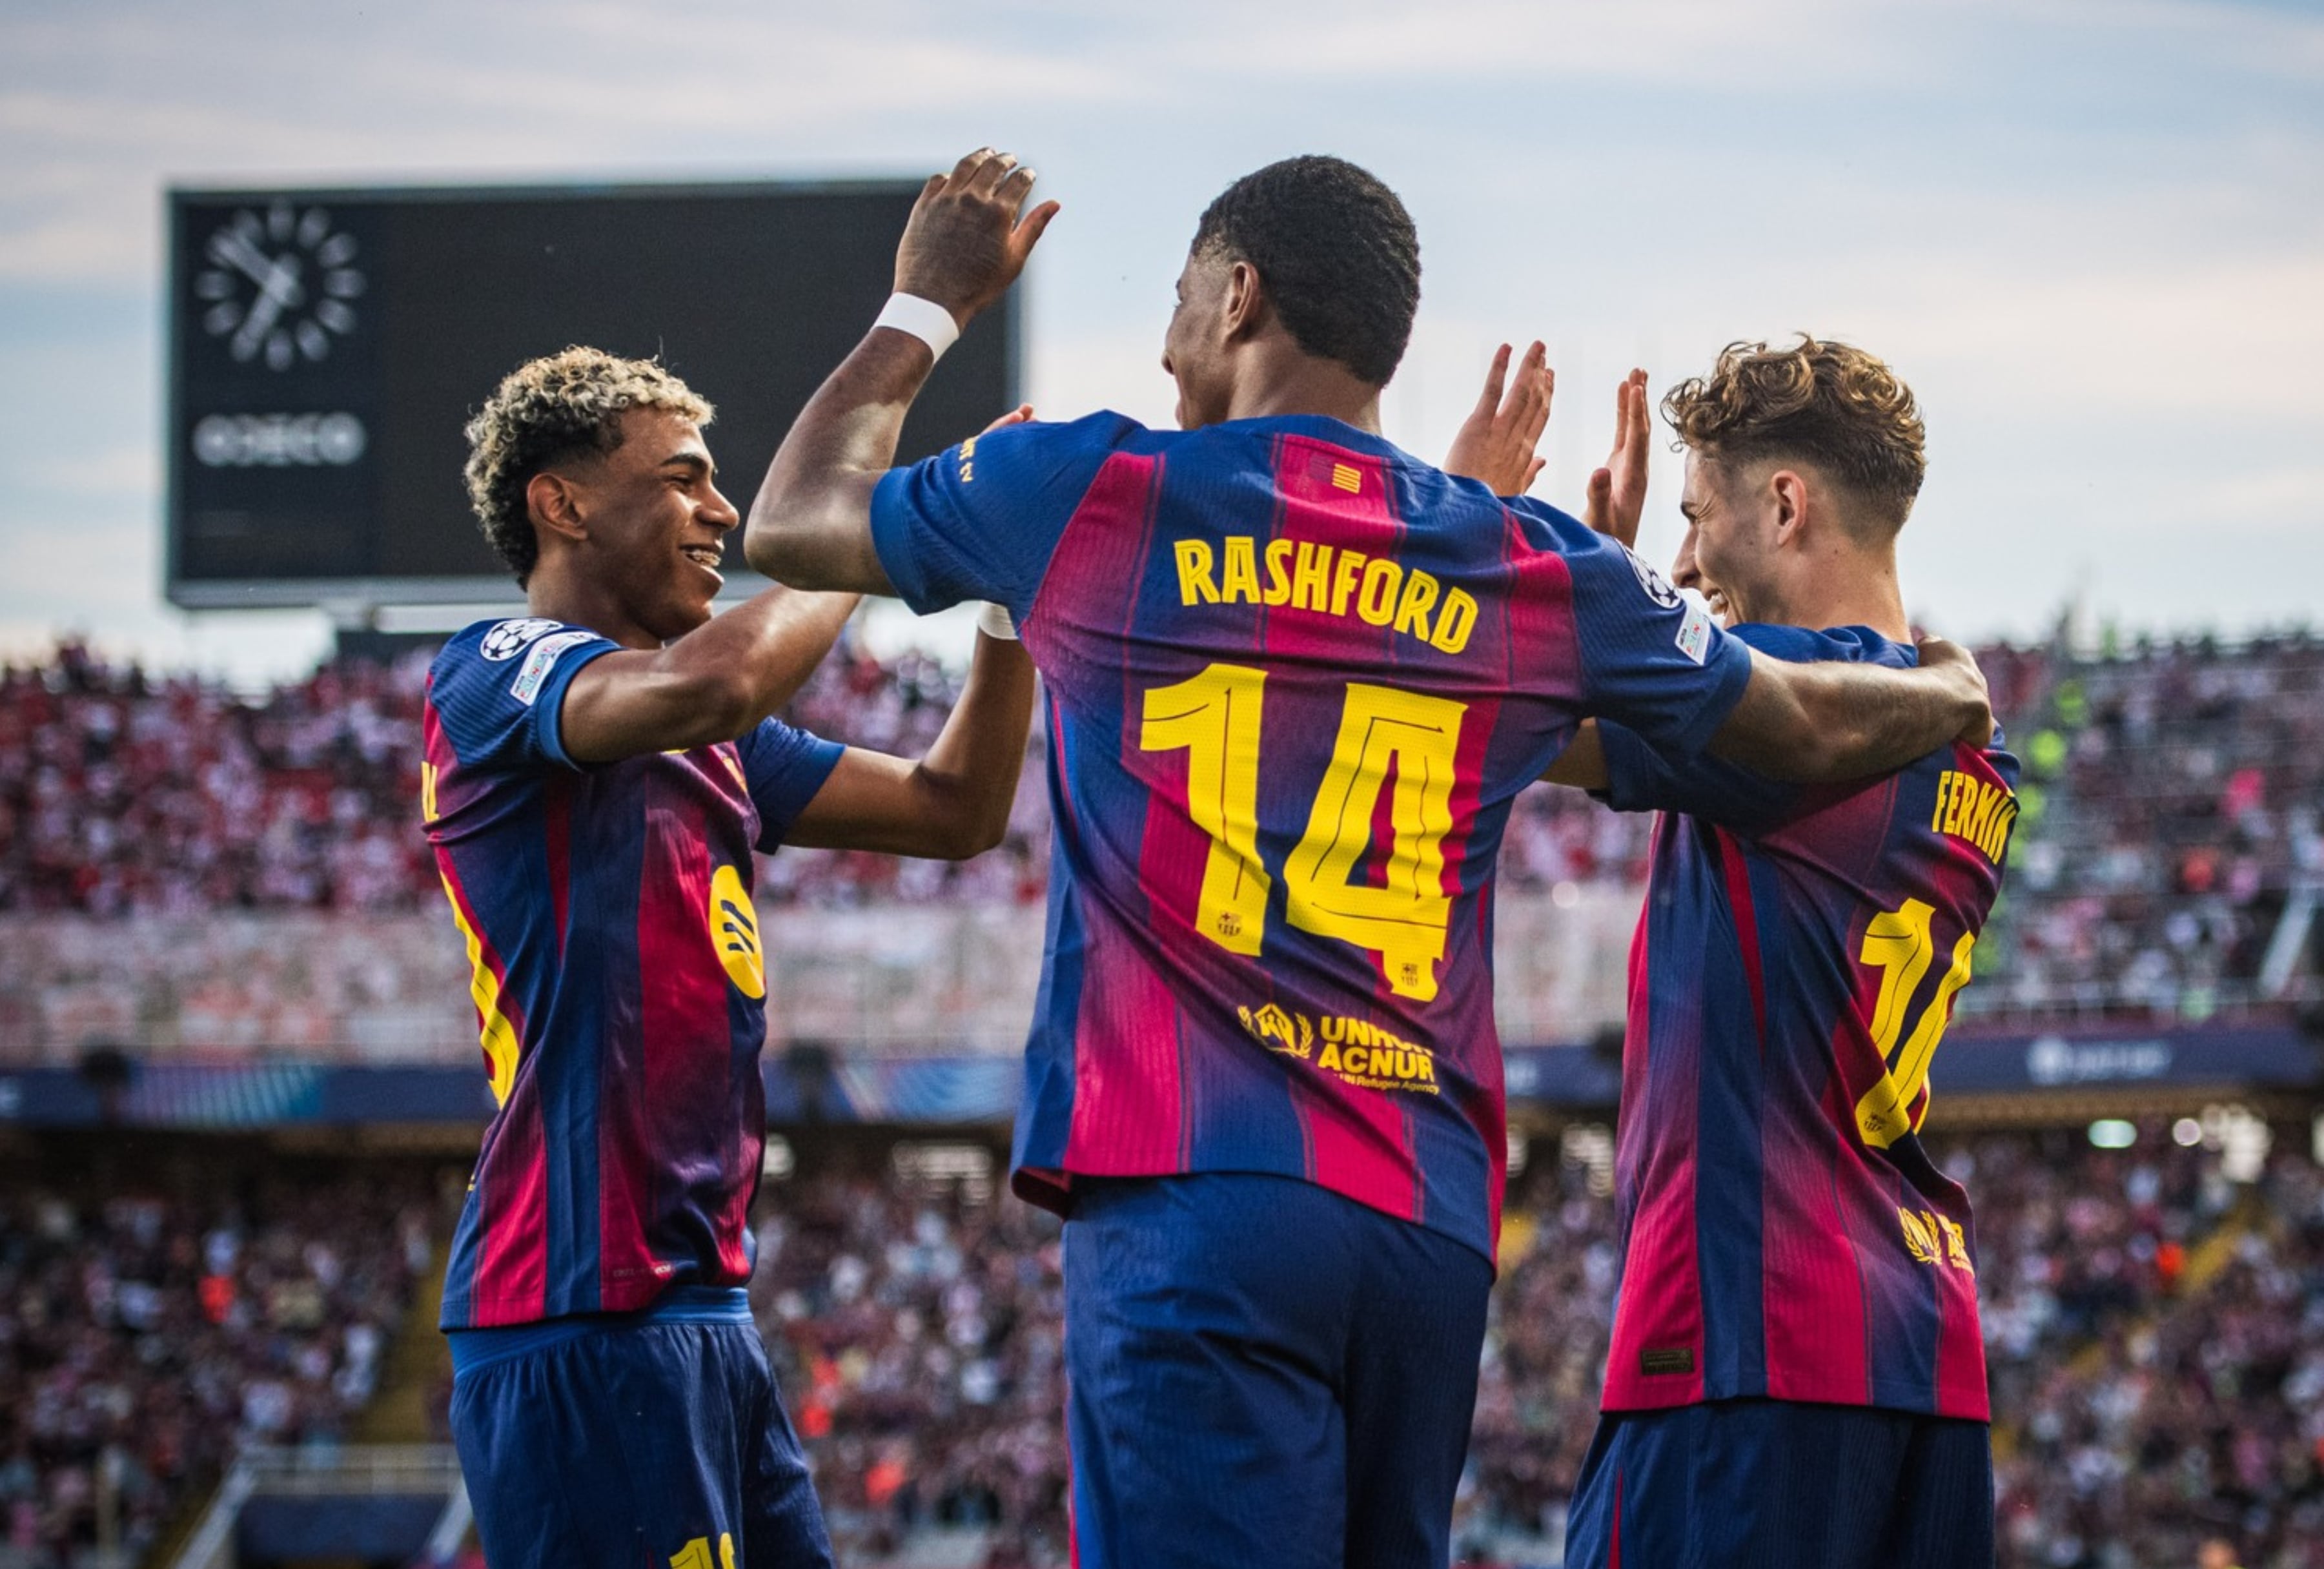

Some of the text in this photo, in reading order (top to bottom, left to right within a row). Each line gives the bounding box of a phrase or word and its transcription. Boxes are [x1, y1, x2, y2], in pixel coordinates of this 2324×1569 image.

[1174, 536, 1478, 654] RASHFORD
[1140, 662, 1469, 1003] 14
[1317, 1043, 1435, 1083] ACNUR
